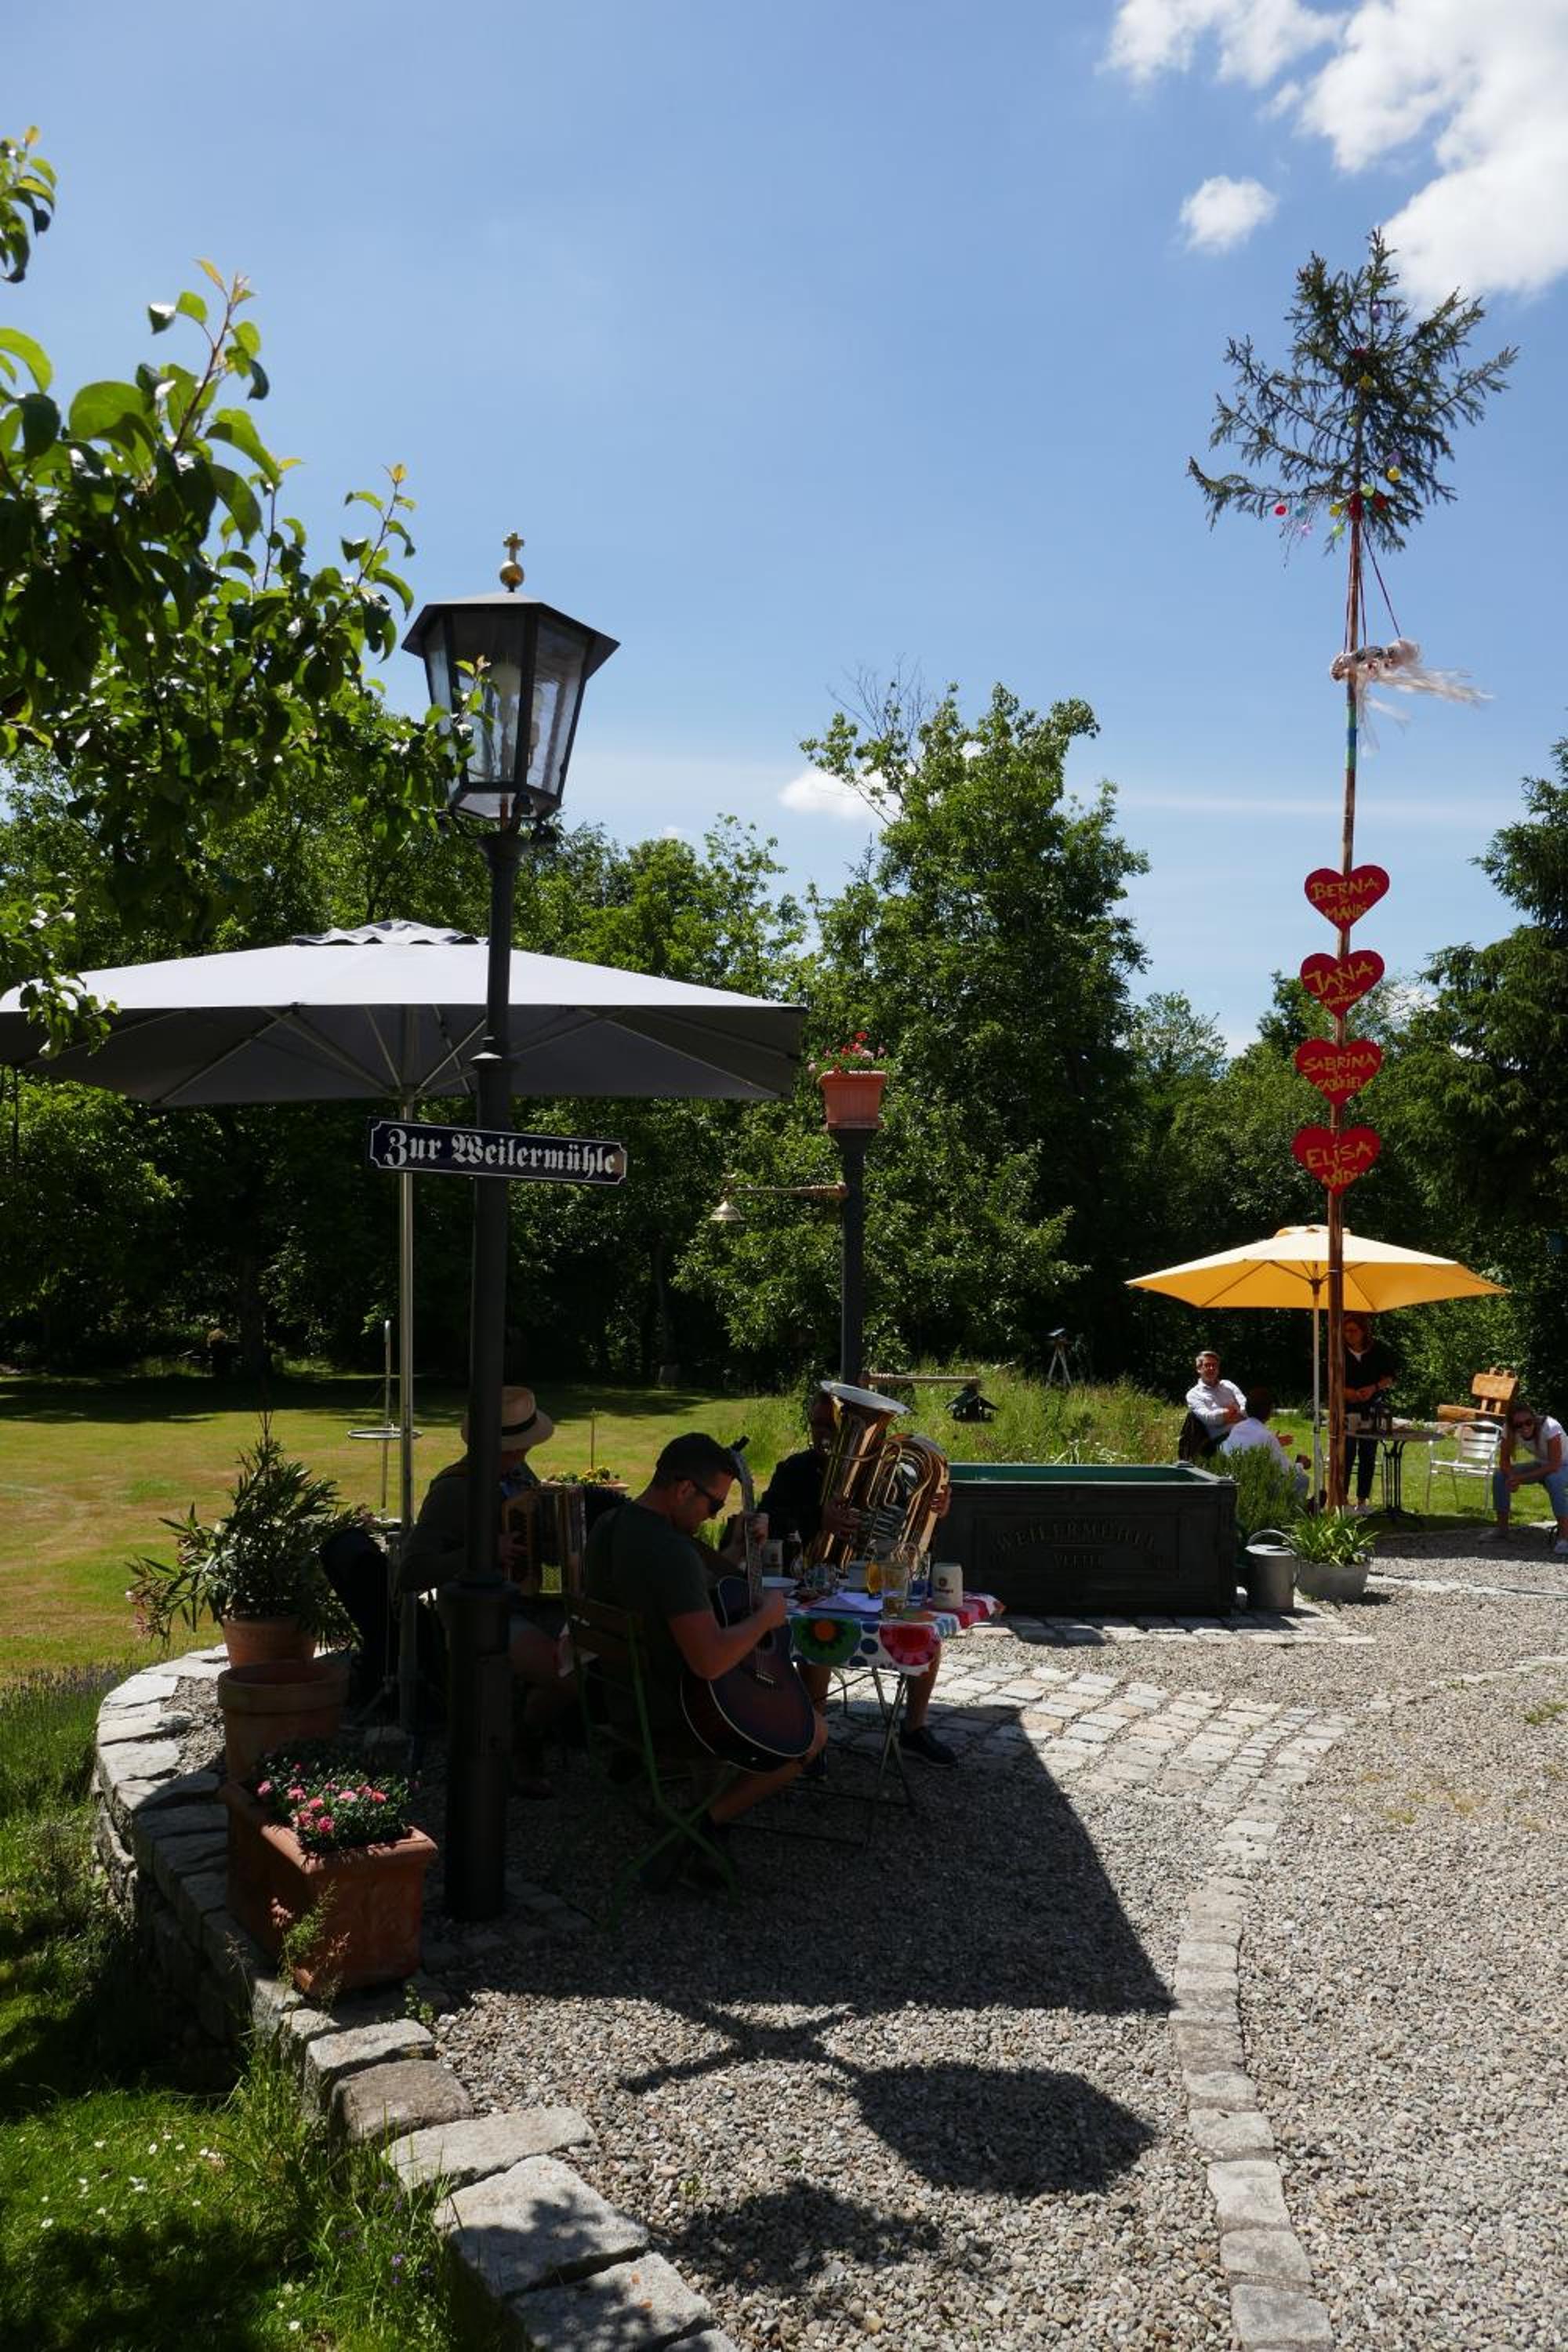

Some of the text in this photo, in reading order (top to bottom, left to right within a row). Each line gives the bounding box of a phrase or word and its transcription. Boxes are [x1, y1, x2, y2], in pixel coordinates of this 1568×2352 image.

[1305, 960, 1374, 996] JANA
[384, 1128, 615, 1179] Zur Weilermühle
